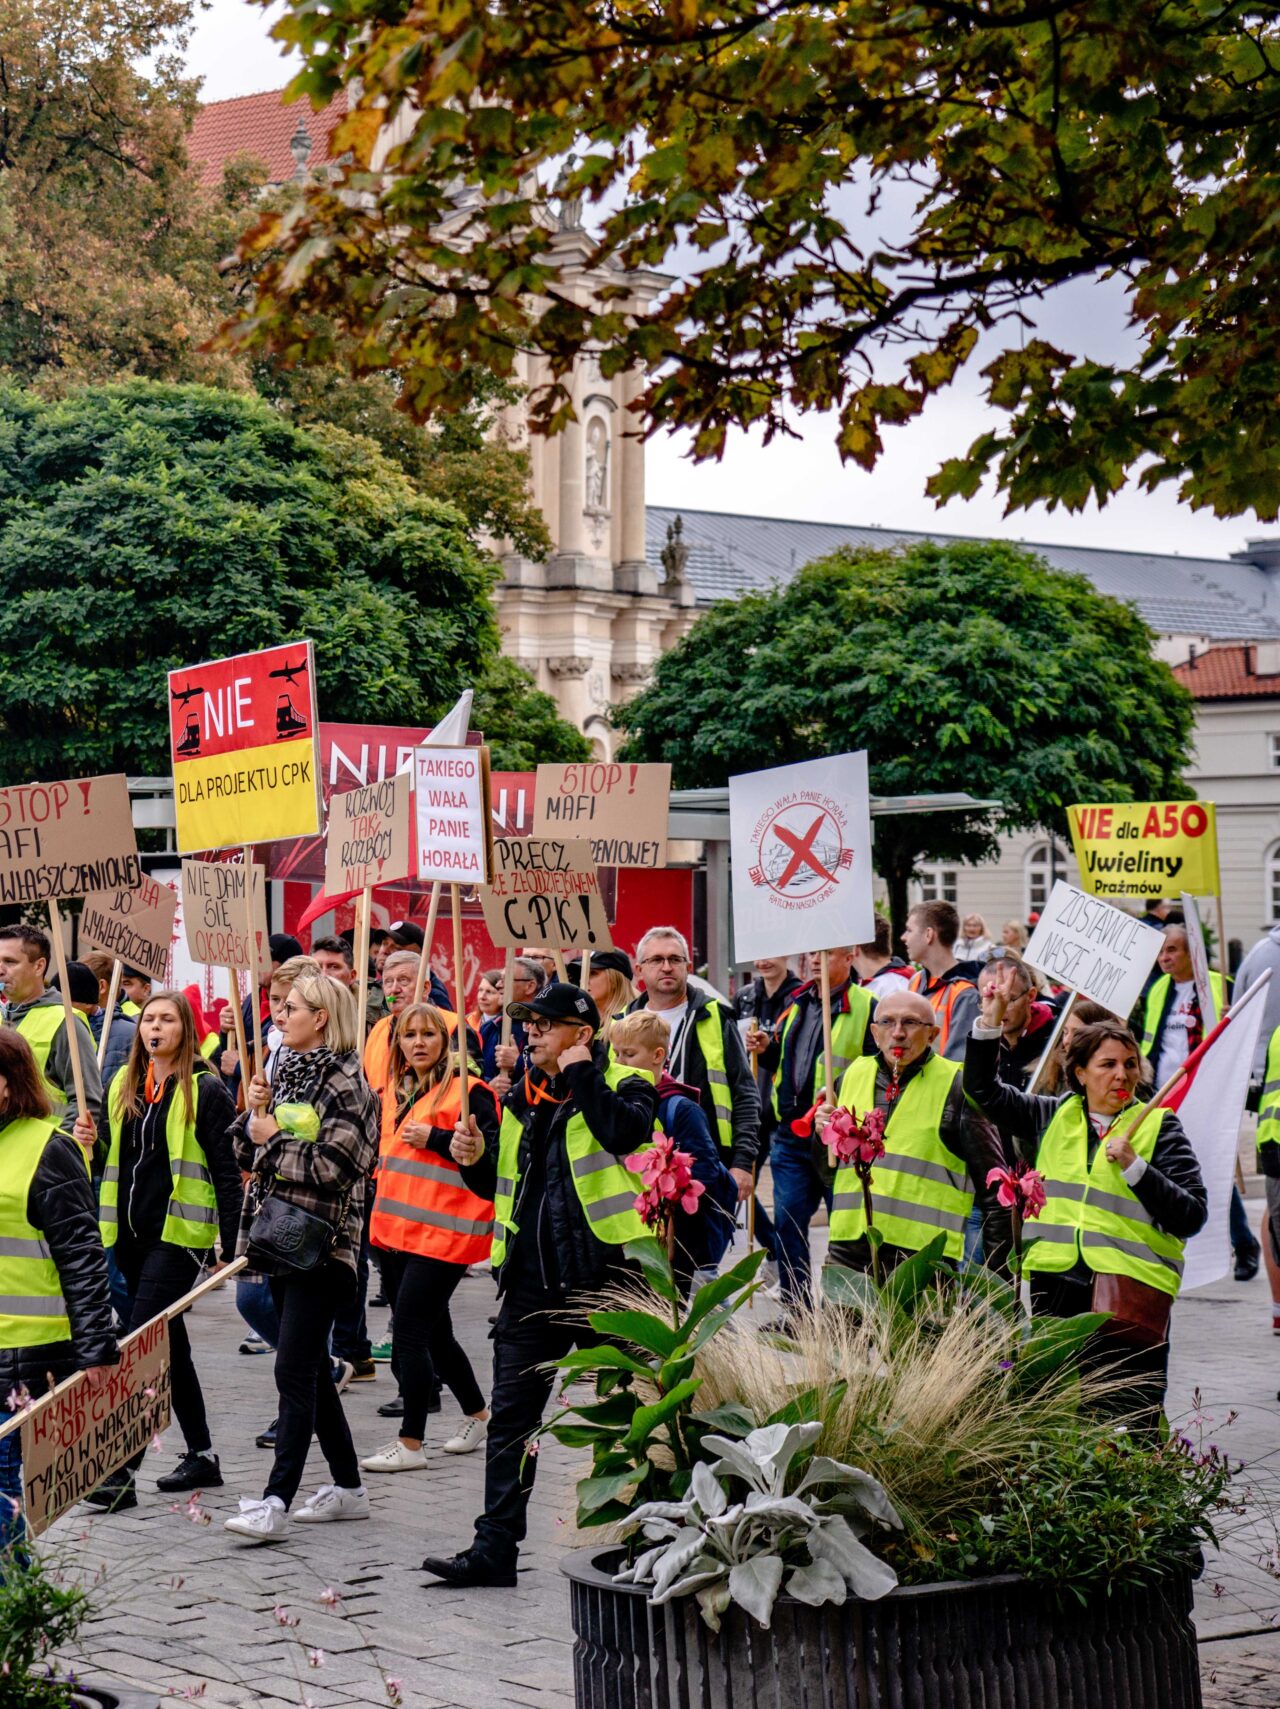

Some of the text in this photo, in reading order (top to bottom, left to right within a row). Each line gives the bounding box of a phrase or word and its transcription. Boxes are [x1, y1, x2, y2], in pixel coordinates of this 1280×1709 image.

[203, 677, 255, 741] NIE
[179, 760, 311, 805] DLA PROJEKTU CPK
[418, 760, 475, 778] TAKIEGO
[429, 790, 469, 809] WAŁA
[547, 795, 596, 821] MAFI
[351, 813, 381, 839] TAK
[429, 819, 470, 838] PANIE
[1116, 821, 1139, 839] dla
[1142, 804, 1208, 838] A50
[422, 849, 479, 871] HORAŁA
[493, 839, 570, 872] PRECZ
[187, 866, 211, 897] NIE
[1095, 880, 1162, 894] Prażmów
[110, 891, 132, 914] DO
[204, 898, 232, 933] SIĘ
[504, 895, 596, 943] CPK!
[1056, 889, 1147, 961] ZOSTAWCIE
[1036, 932, 1127, 1003] NASZE DOMY
